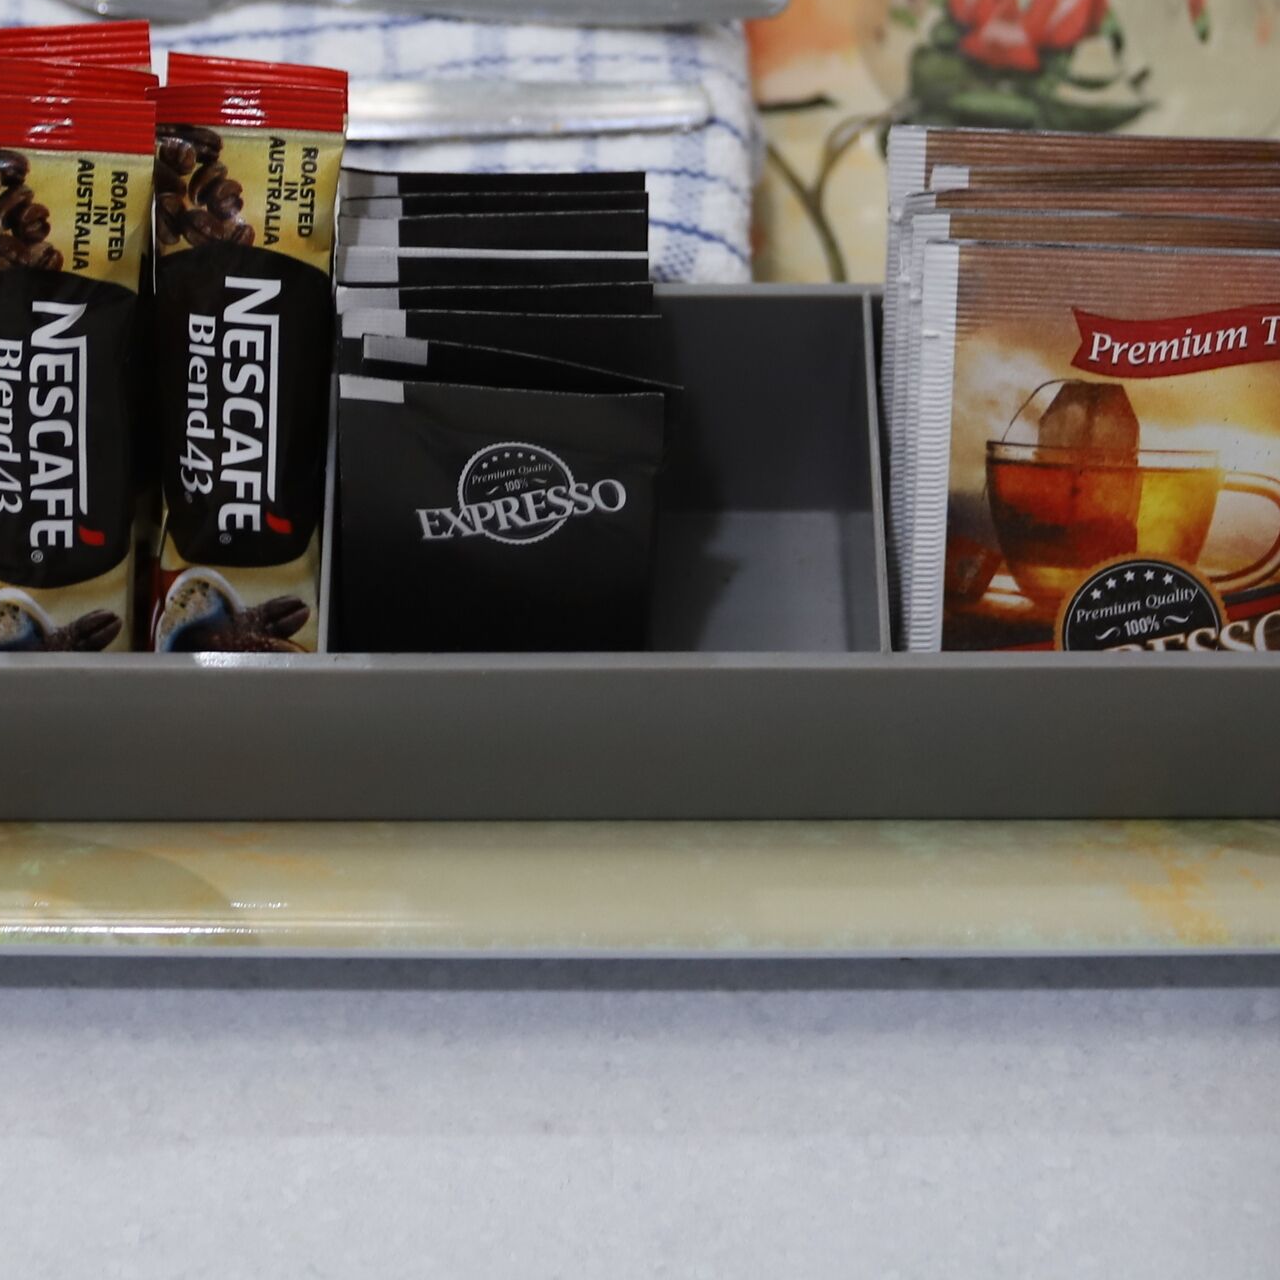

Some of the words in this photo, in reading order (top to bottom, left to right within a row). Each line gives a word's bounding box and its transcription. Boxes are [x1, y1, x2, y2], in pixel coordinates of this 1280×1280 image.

[264, 136, 286, 245] AUSTRALIA
[283, 181, 299, 201] IN
[300, 147, 319, 238] ROASTED
[72, 158, 95, 271] AUSTRALIA
[93, 205, 108, 225] IN
[108, 171, 129, 261] ROASTED
[1088, 328, 1248, 366] Premium
[471, 467, 516, 486] Premium
[518, 462, 554, 476] Quality
[504, 477, 529, 493] 100%
[415, 478, 627, 540] EXPRESSO
[1075, 600, 1142, 624] Premium
[1144, 588, 1199, 611] Quality
[1124, 615, 1161, 637] 100%
